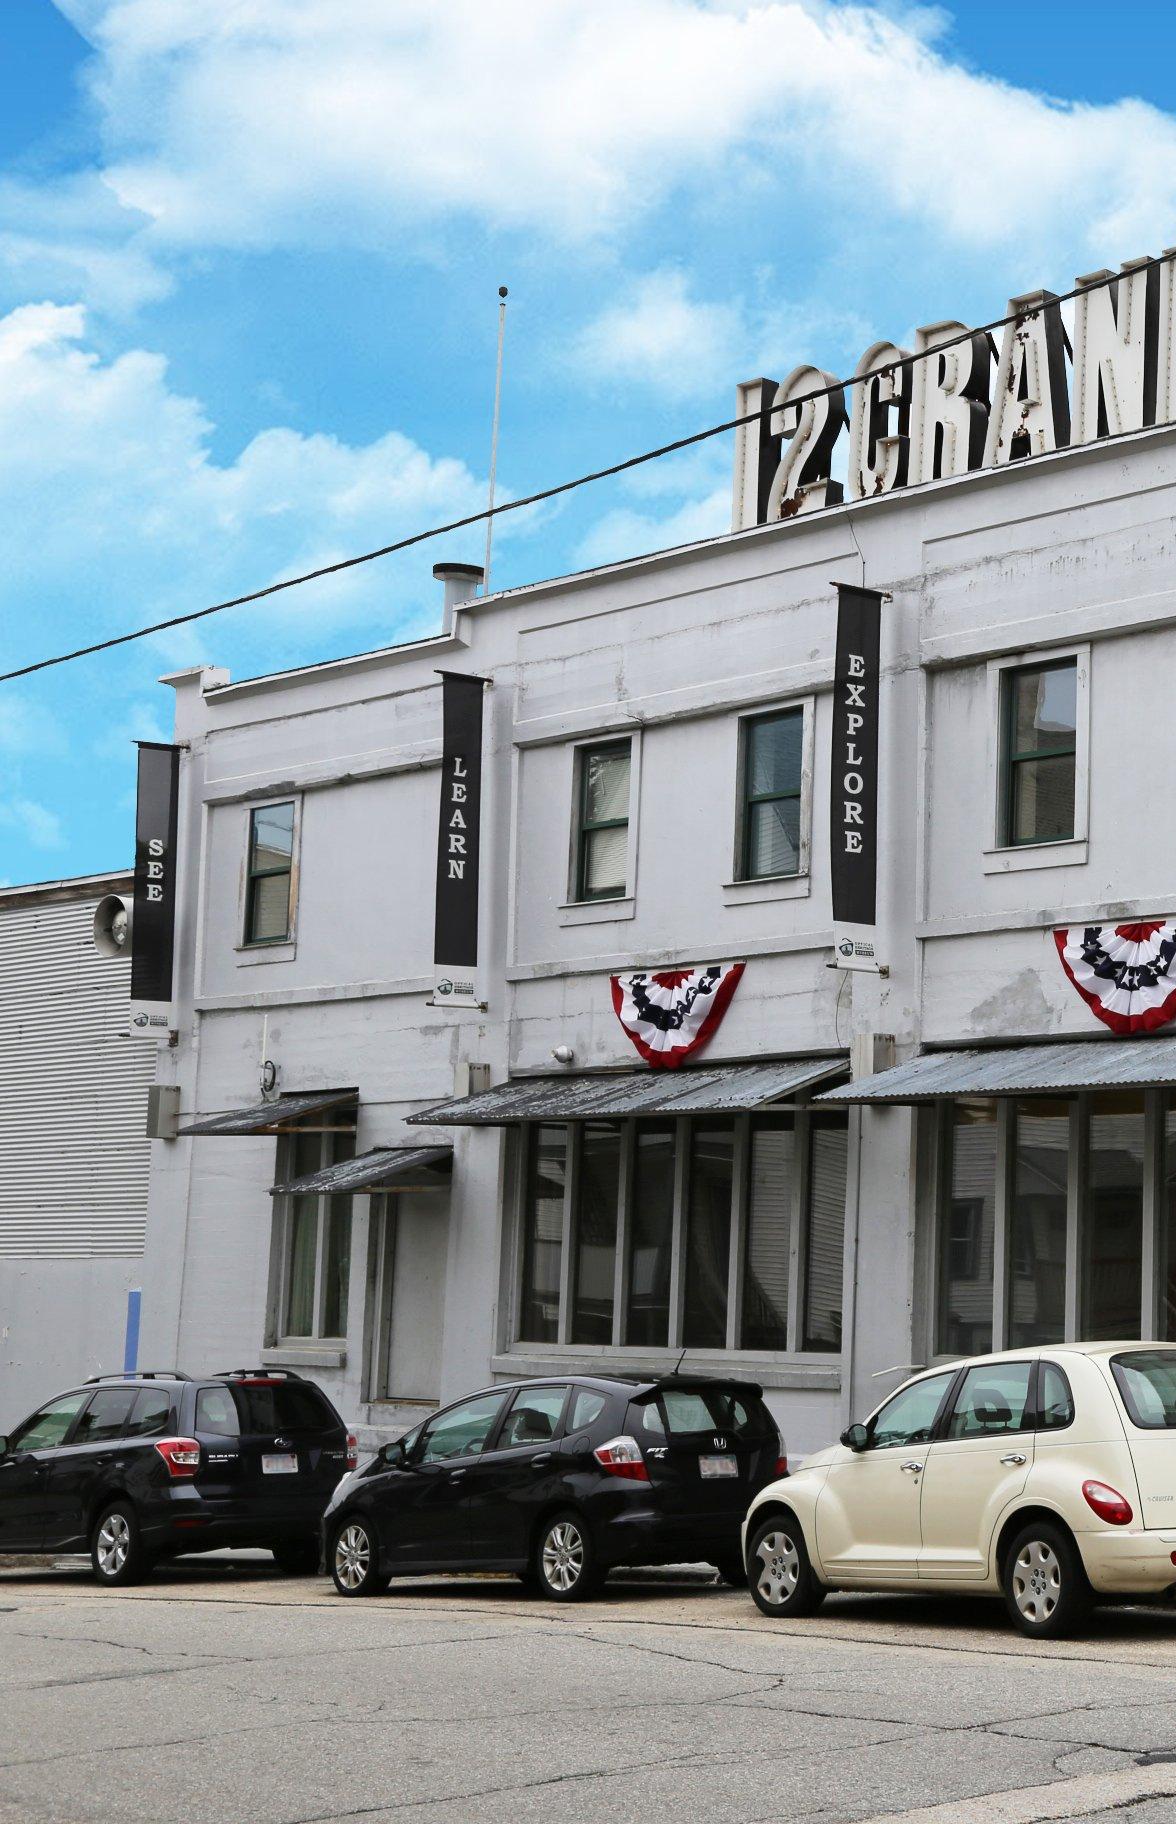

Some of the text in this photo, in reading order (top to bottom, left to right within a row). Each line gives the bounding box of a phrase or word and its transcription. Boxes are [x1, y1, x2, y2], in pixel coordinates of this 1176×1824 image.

[731, 364, 844, 533] 12
[448, 757, 467, 879] LEARN
[843, 653, 866, 854] EXPLORE
[146, 838, 164, 902] SEE
